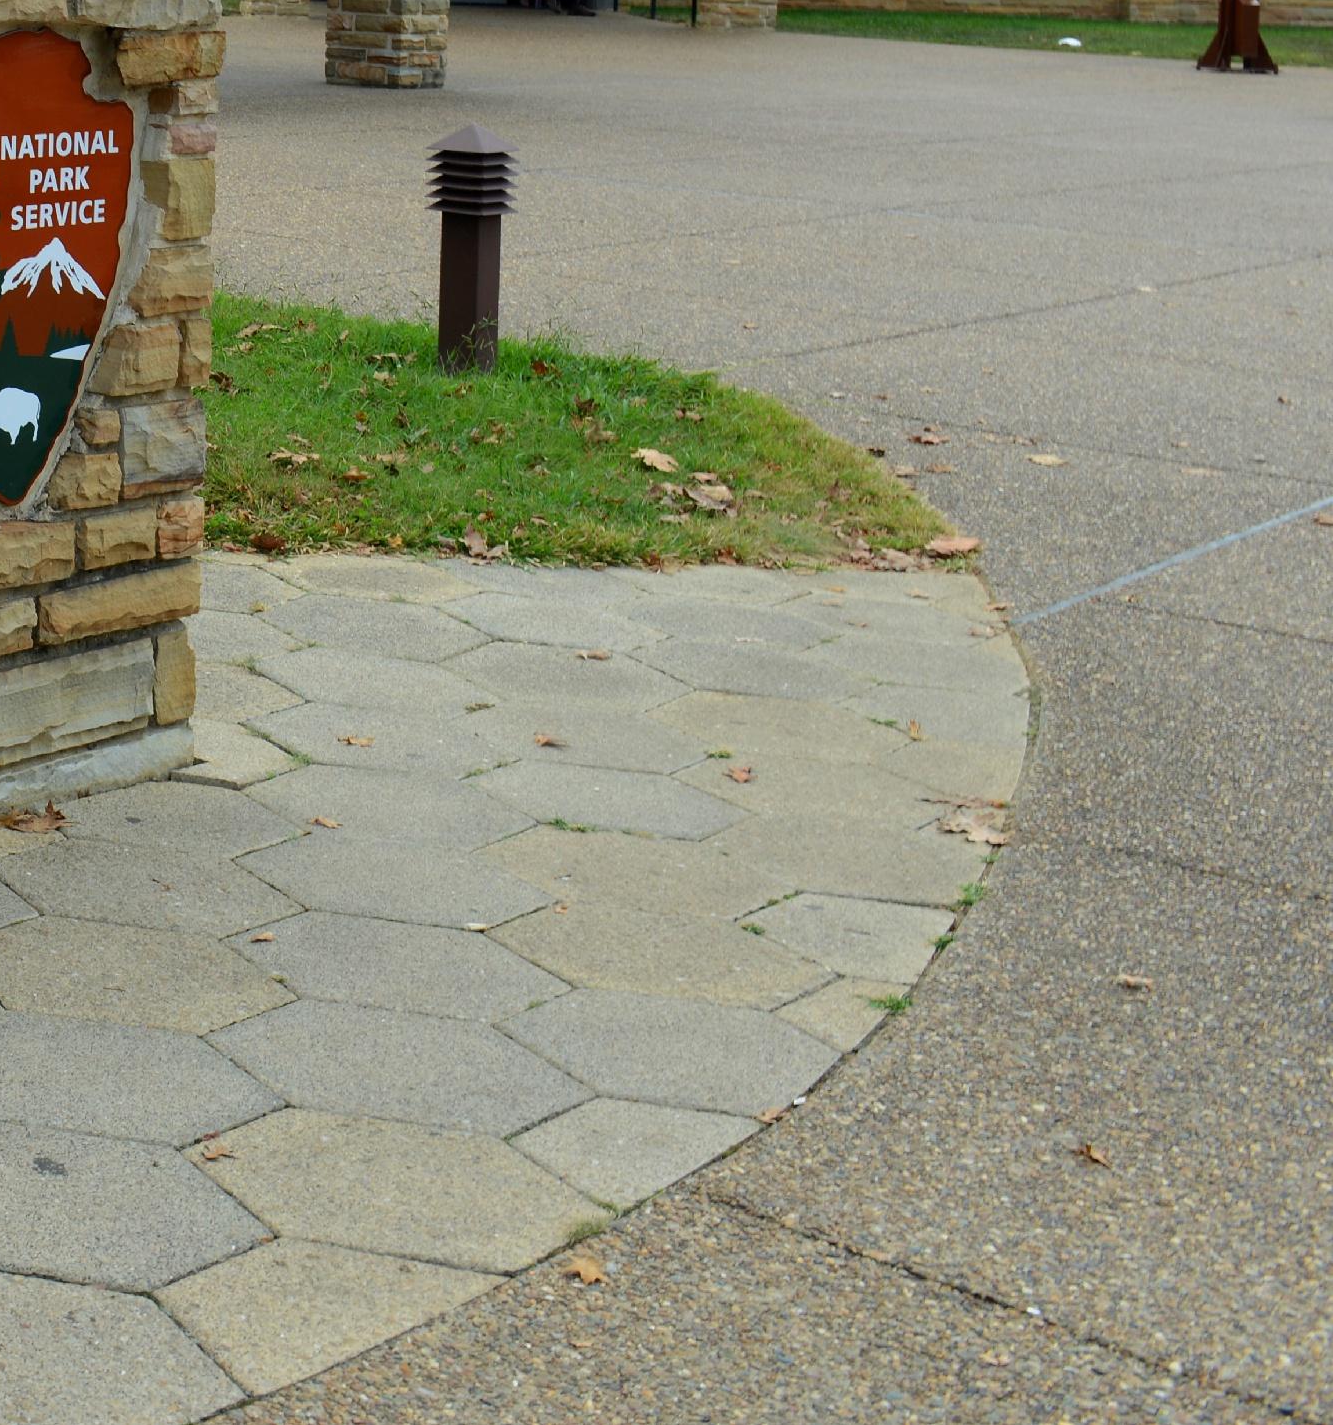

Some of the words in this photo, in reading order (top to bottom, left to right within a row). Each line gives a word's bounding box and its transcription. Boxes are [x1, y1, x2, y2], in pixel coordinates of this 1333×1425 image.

[0, 129, 119, 161] NATIONAL
[29, 165, 90, 194] PARK
[10, 198, 106, 231] SERVICE
